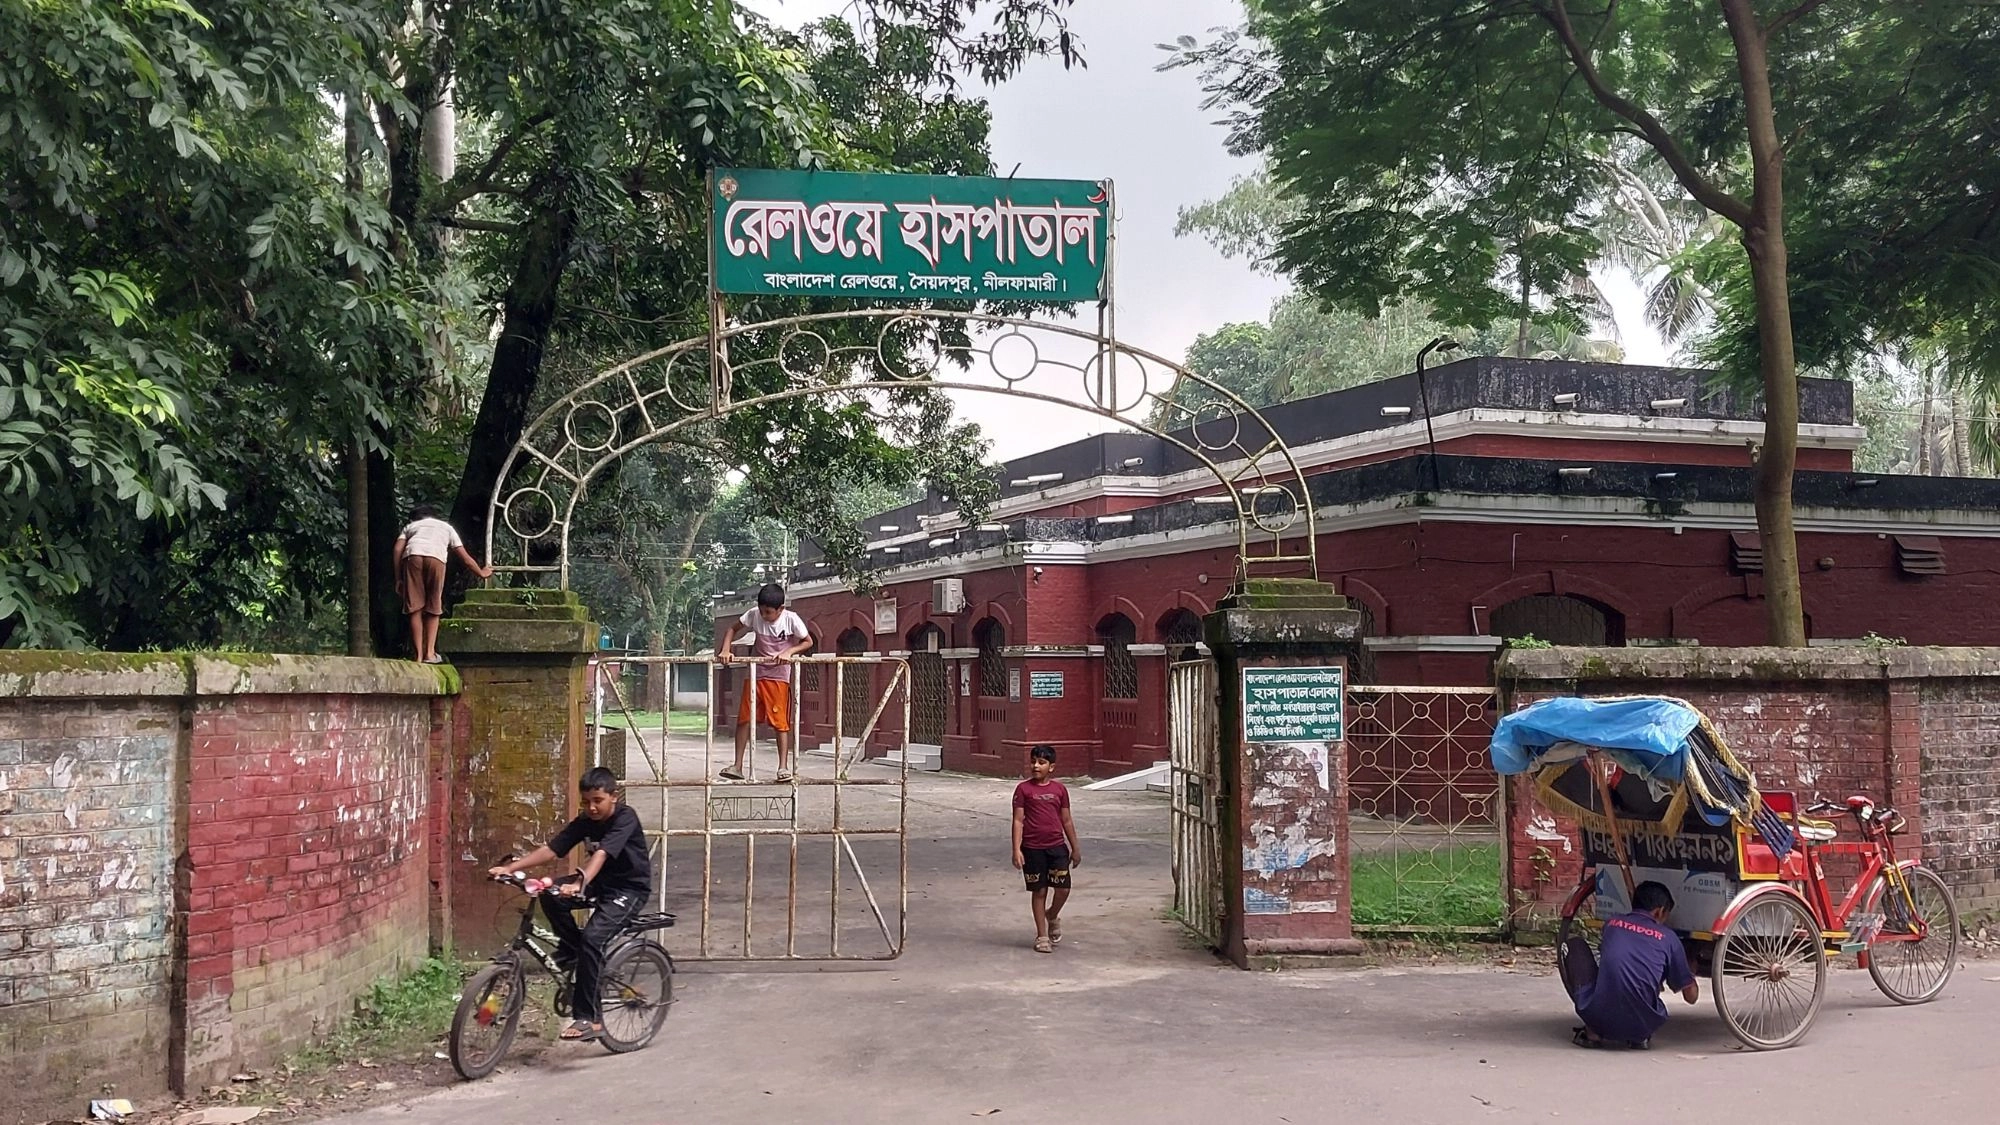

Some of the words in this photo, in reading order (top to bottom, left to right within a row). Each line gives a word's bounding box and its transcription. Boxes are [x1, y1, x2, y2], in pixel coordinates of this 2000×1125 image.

[724, 200, 889, 264] রেলওয়ে
[894, 196, 1102, 271] হাসপাতাল
[763, 273, 835, 289] বাংলাদেশ
[1251, 687, 1309, 700] হাসপাতাল
[1309, 687, 1339, 699] এলাকা
[711, 797, 793, 820] RAILWAY
